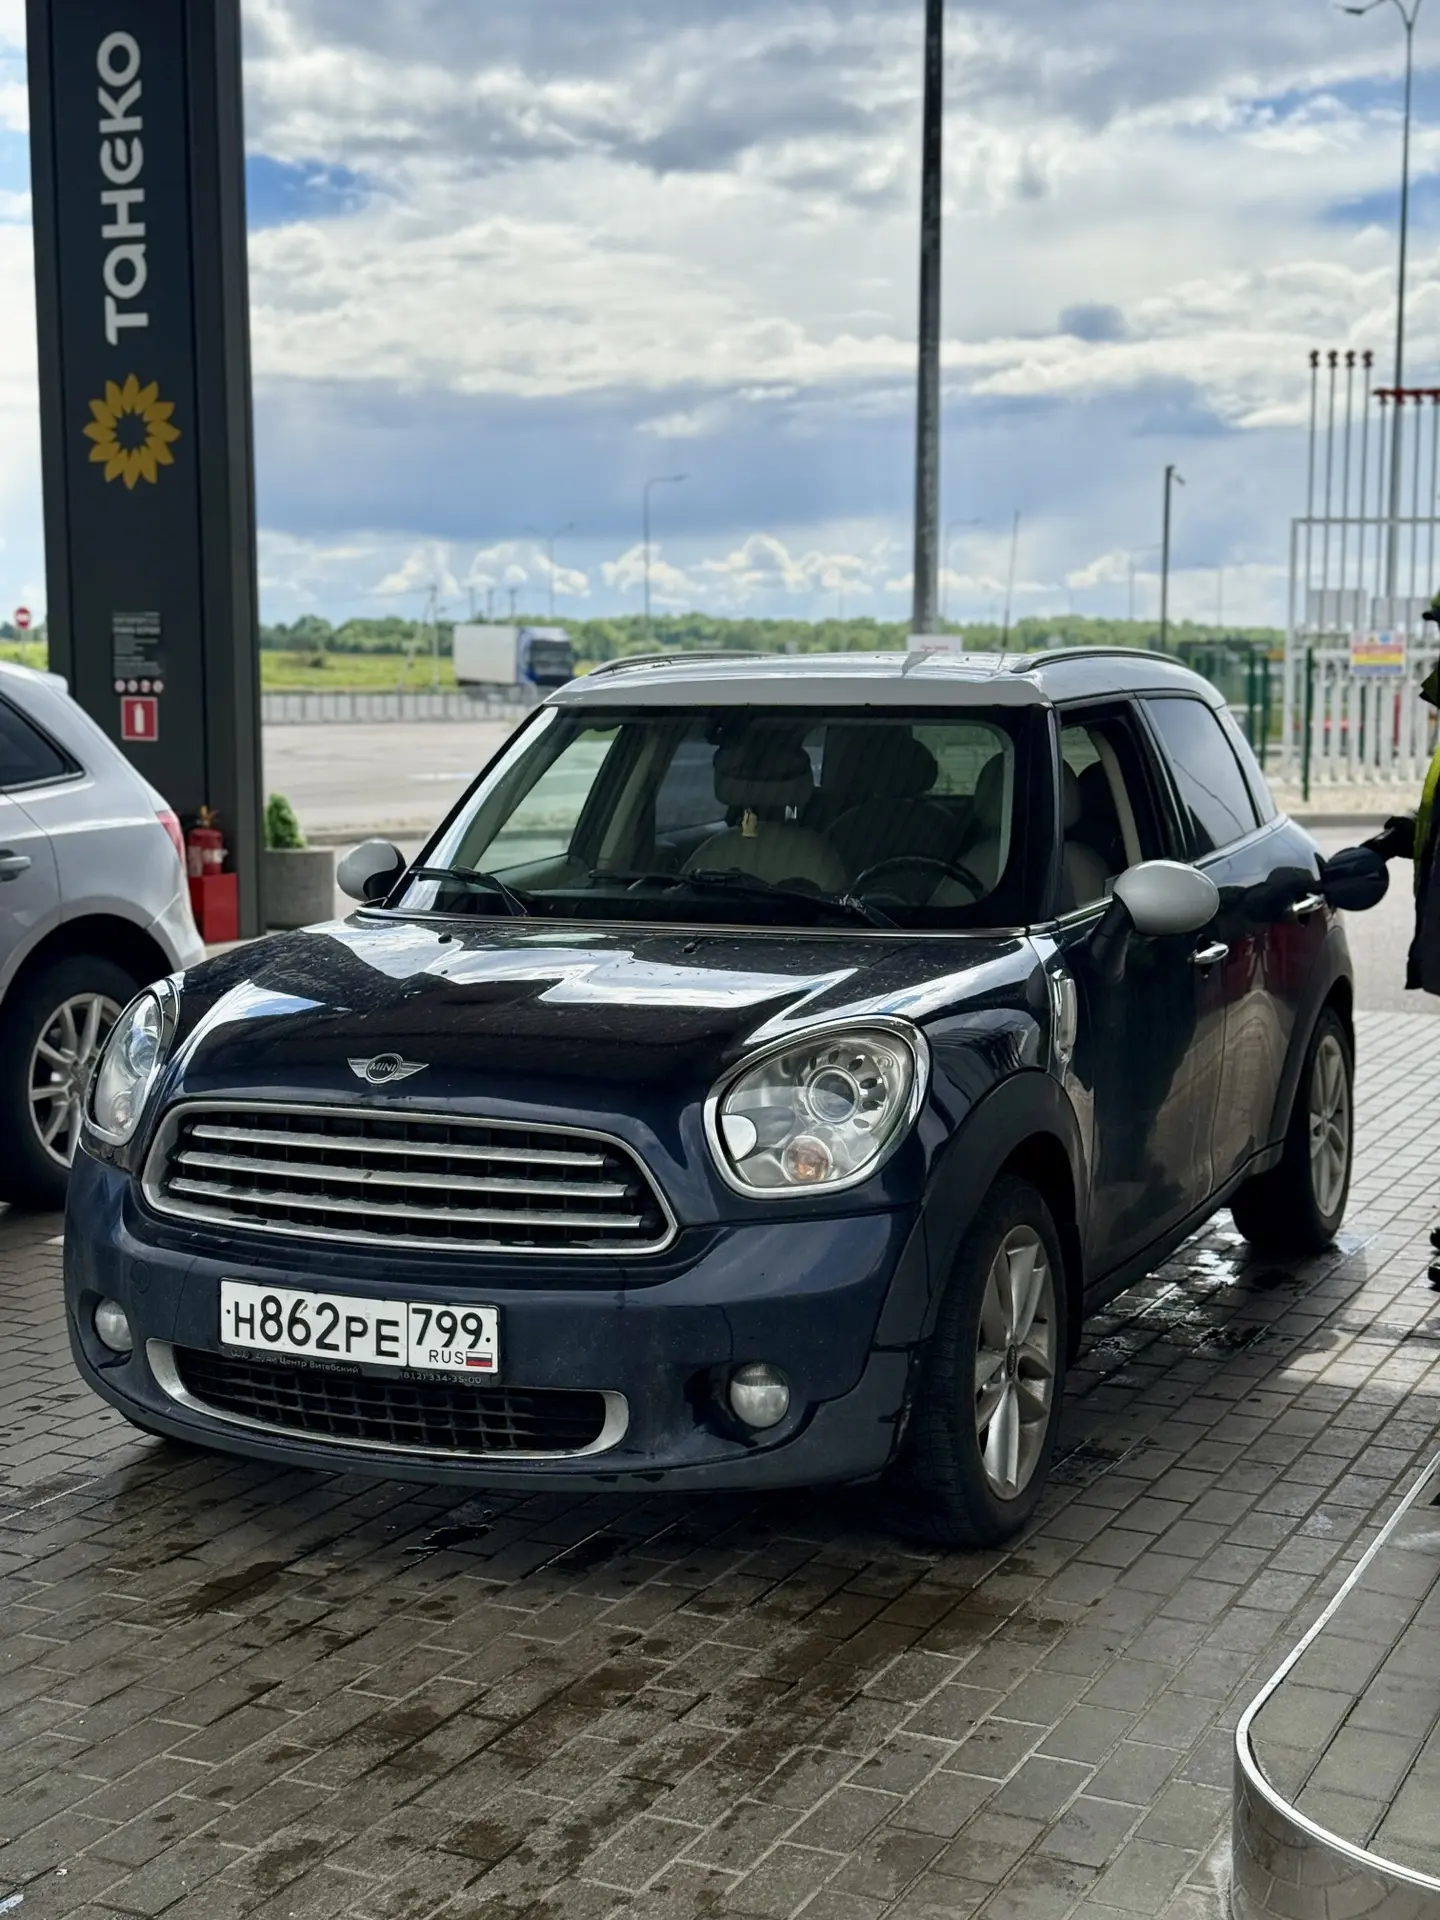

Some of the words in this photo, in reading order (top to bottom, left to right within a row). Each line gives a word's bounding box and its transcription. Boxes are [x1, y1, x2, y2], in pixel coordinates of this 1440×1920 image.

[369, 1062, 397, 1072] MINI
[411, 1307, 483, 1350] 799
[279, 1355, 308, 1369] Центр
[309, 1361, 360, 1375] Витебский
[428, 1349, 464, 1365] RUS
